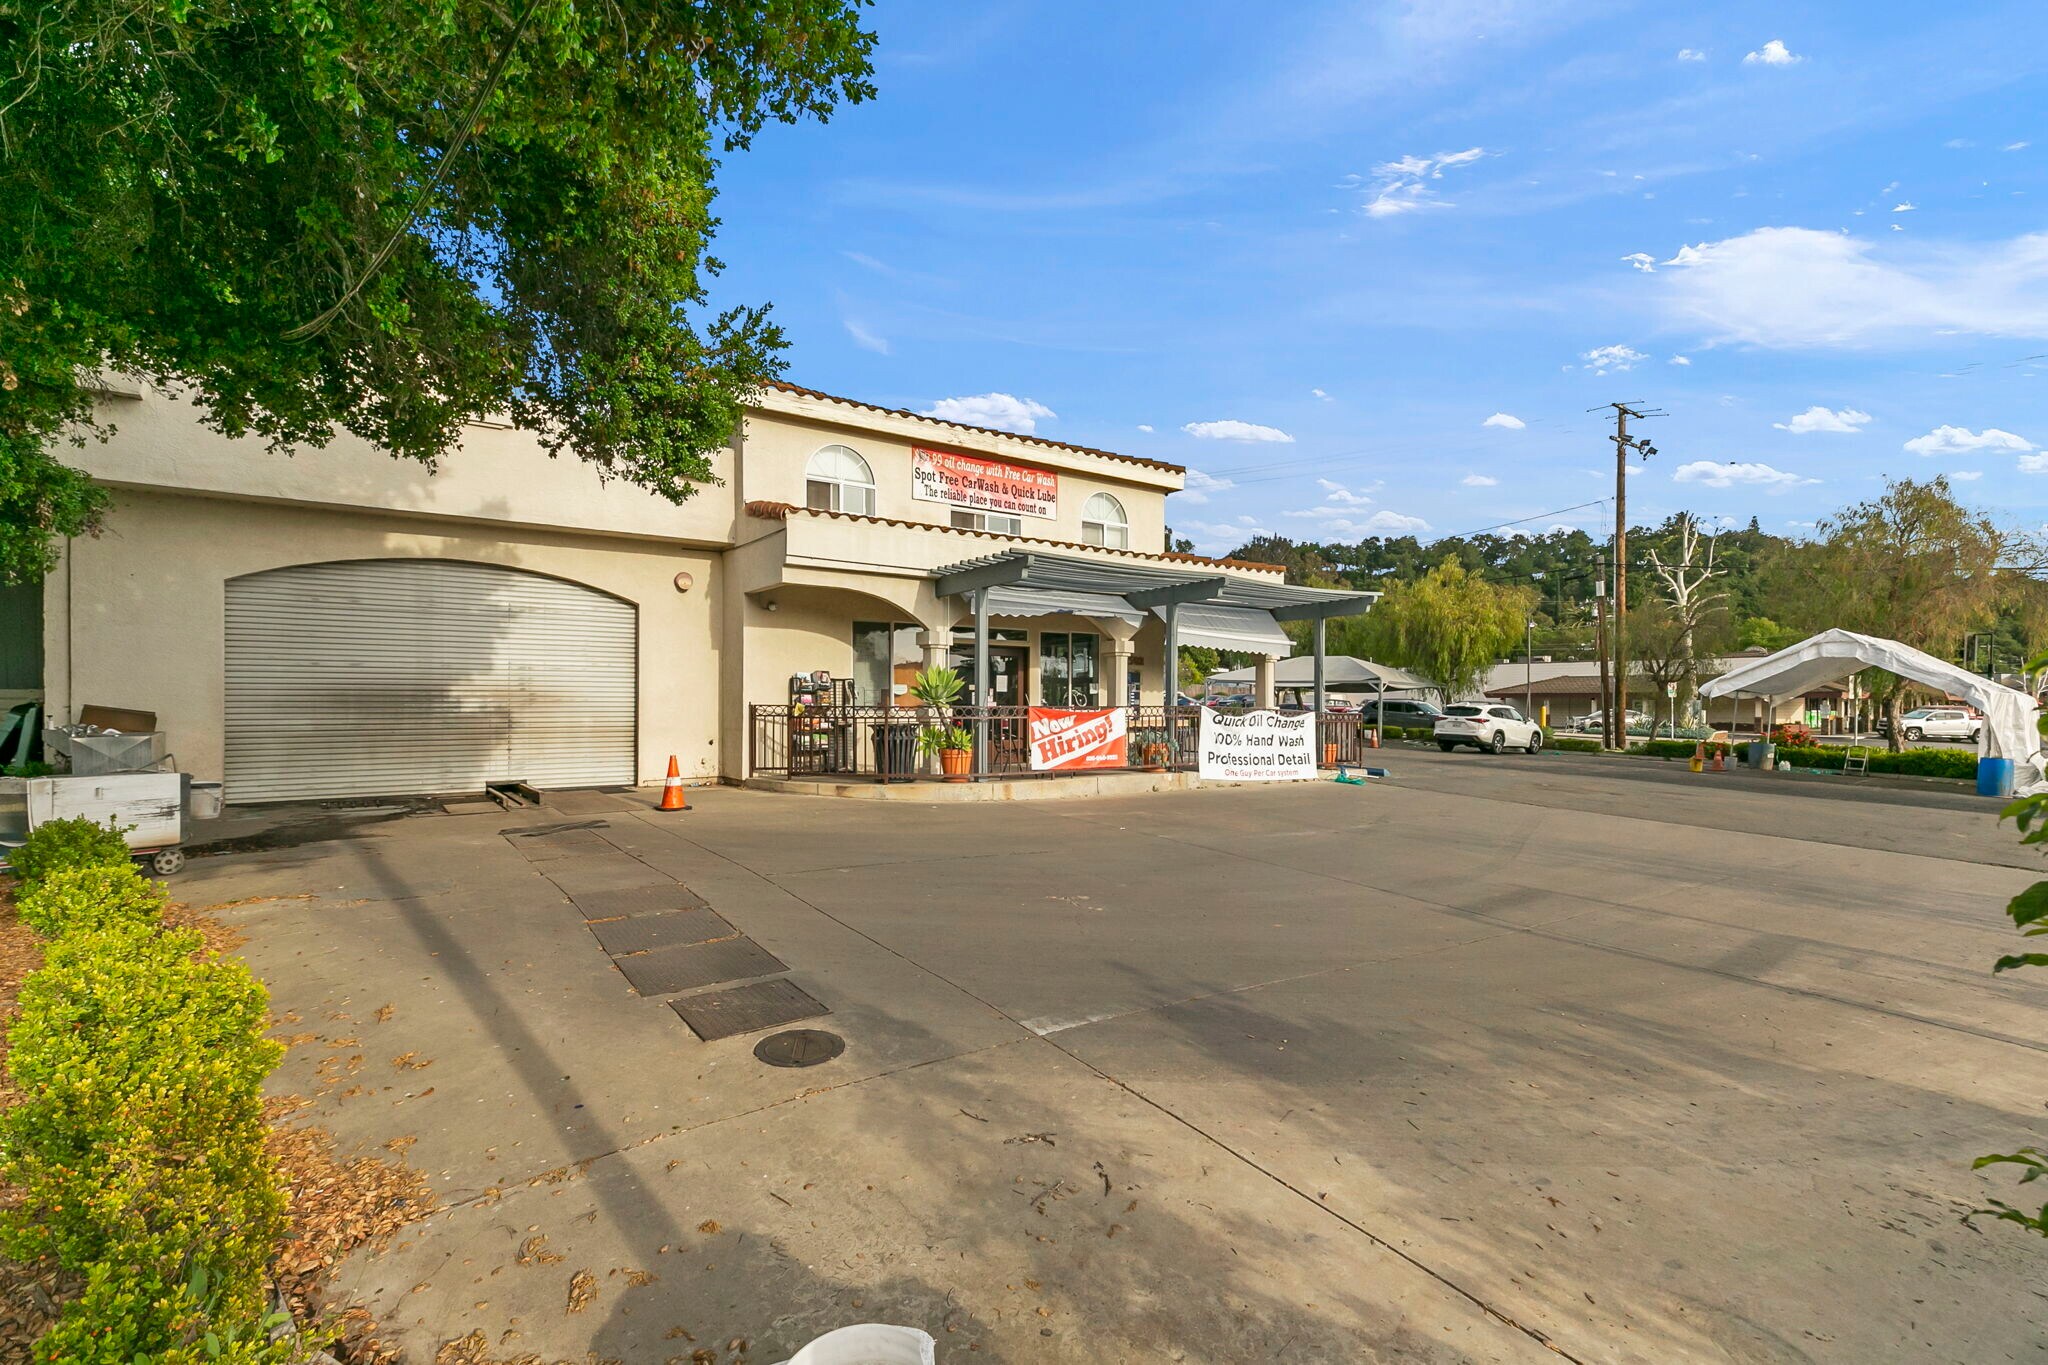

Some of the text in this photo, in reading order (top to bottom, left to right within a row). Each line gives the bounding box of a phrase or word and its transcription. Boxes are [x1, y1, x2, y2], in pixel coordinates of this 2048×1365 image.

[944, 456, 955, 468] oil
[957, 461, 985, 476] change
[986, 465, 1002, 478] with
[1005, 467, 1020, 480] Free
[1022, 470, 1034, 482] Car
[1037, 473, 1055, 486] Wash
[915, 467, 1055, 503] Spot Free CarWash & Quick Lube
[924, 484, 1046, 515] The reliable place you can count on
[1031, 714, 1077, 740] Now
[1212, 714, 1305, 730] Quick Oil Change
[1038, 715, 1113, 763] Hiring!
[1246, 734, 1274, 746] Hand
[1278, 735, 1305, 747] Wash
[1208, 752, 1311, 766] Professional Detail
[1240, 769, 1251, 778] Guy
